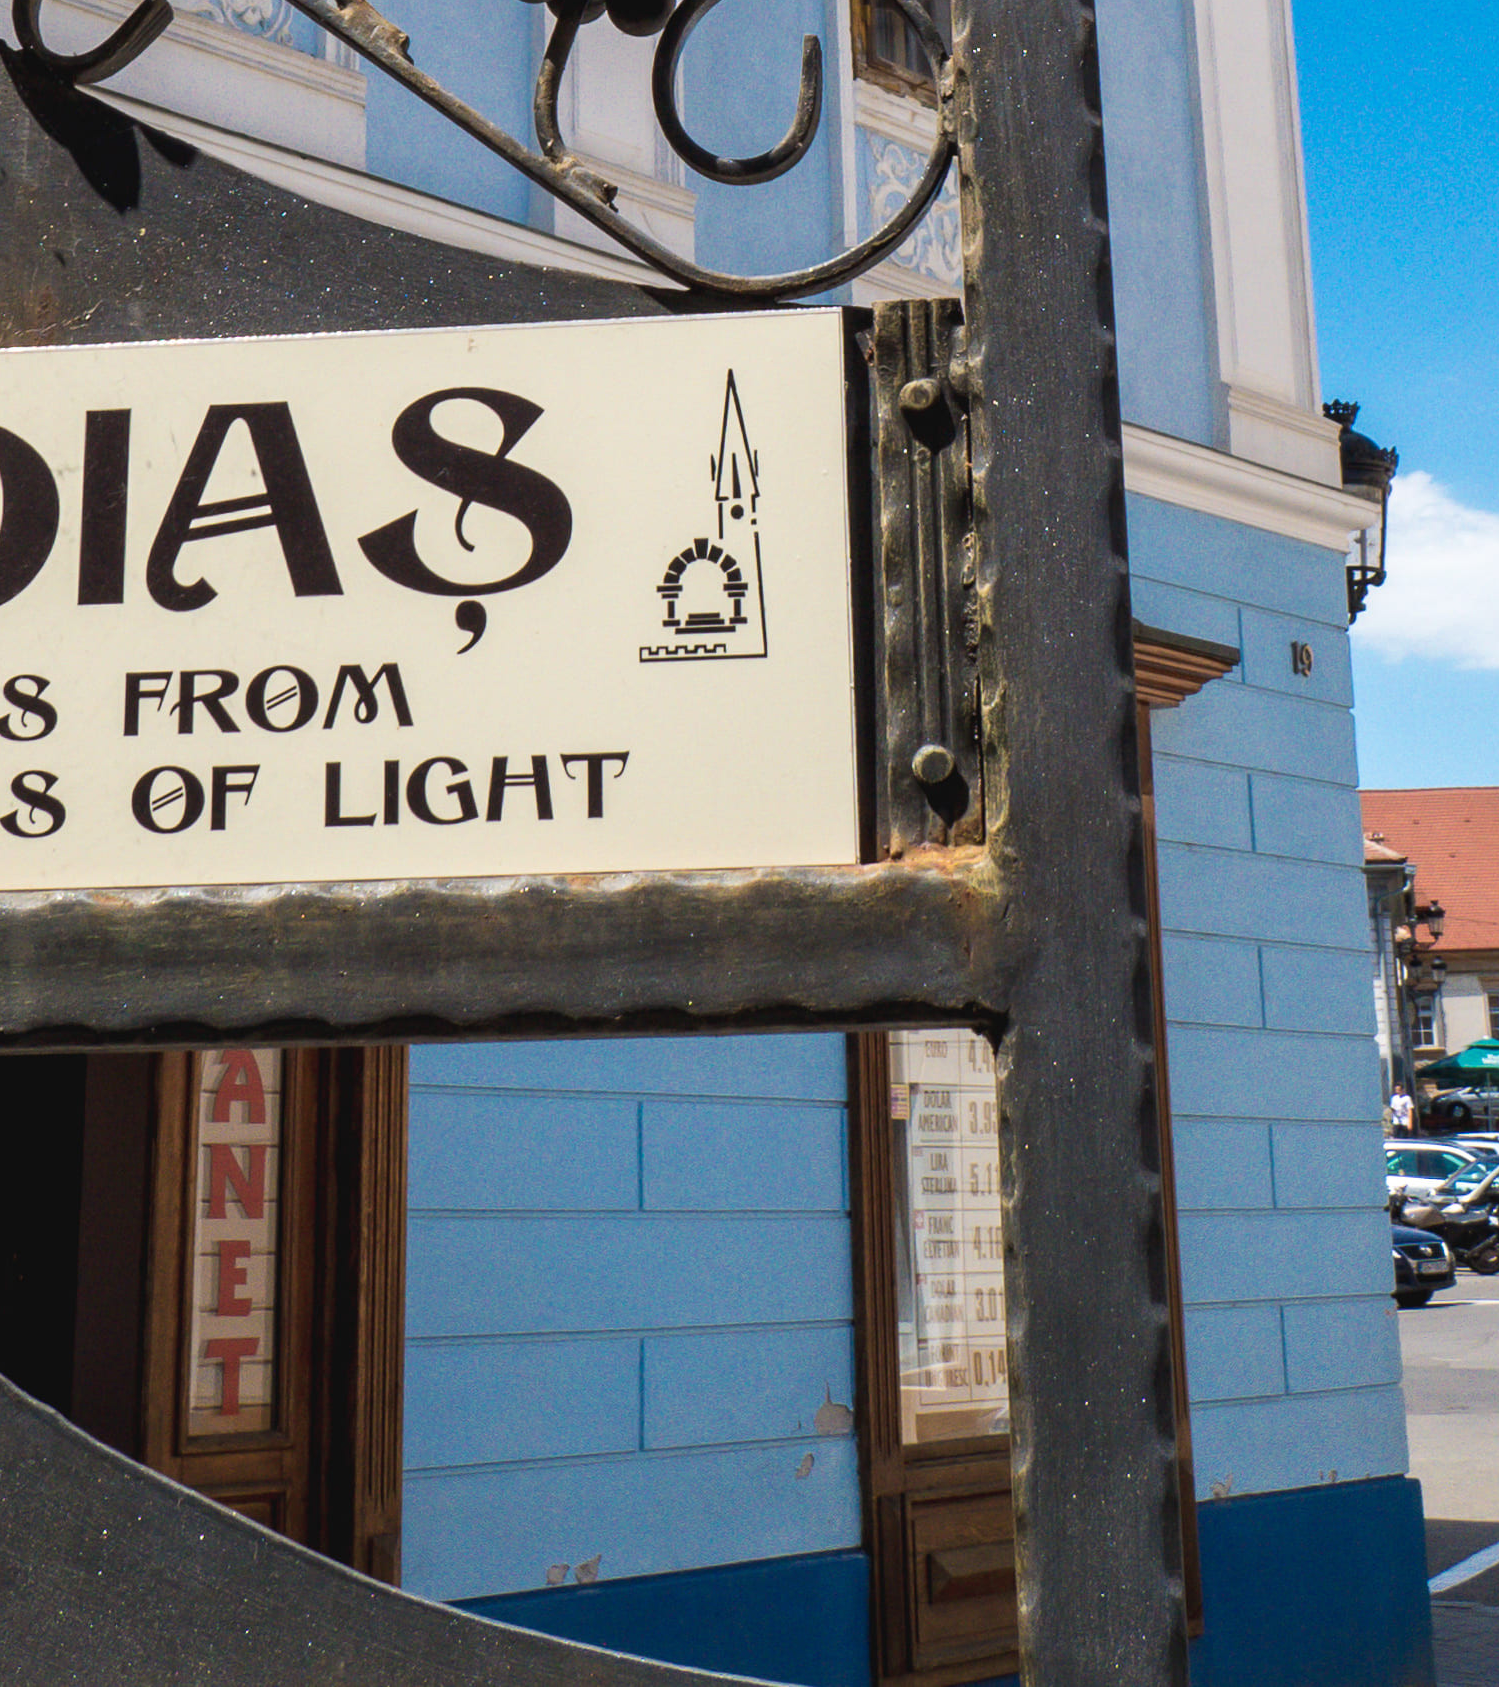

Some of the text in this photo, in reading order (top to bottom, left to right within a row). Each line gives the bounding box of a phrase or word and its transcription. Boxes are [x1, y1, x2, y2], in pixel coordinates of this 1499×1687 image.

[1290, 639, 1314, 677] 19
[123, 663, 414, 738] FROM
[131, 764, 260, 834] OF
[324, 751, 630, 827] LIGHT
